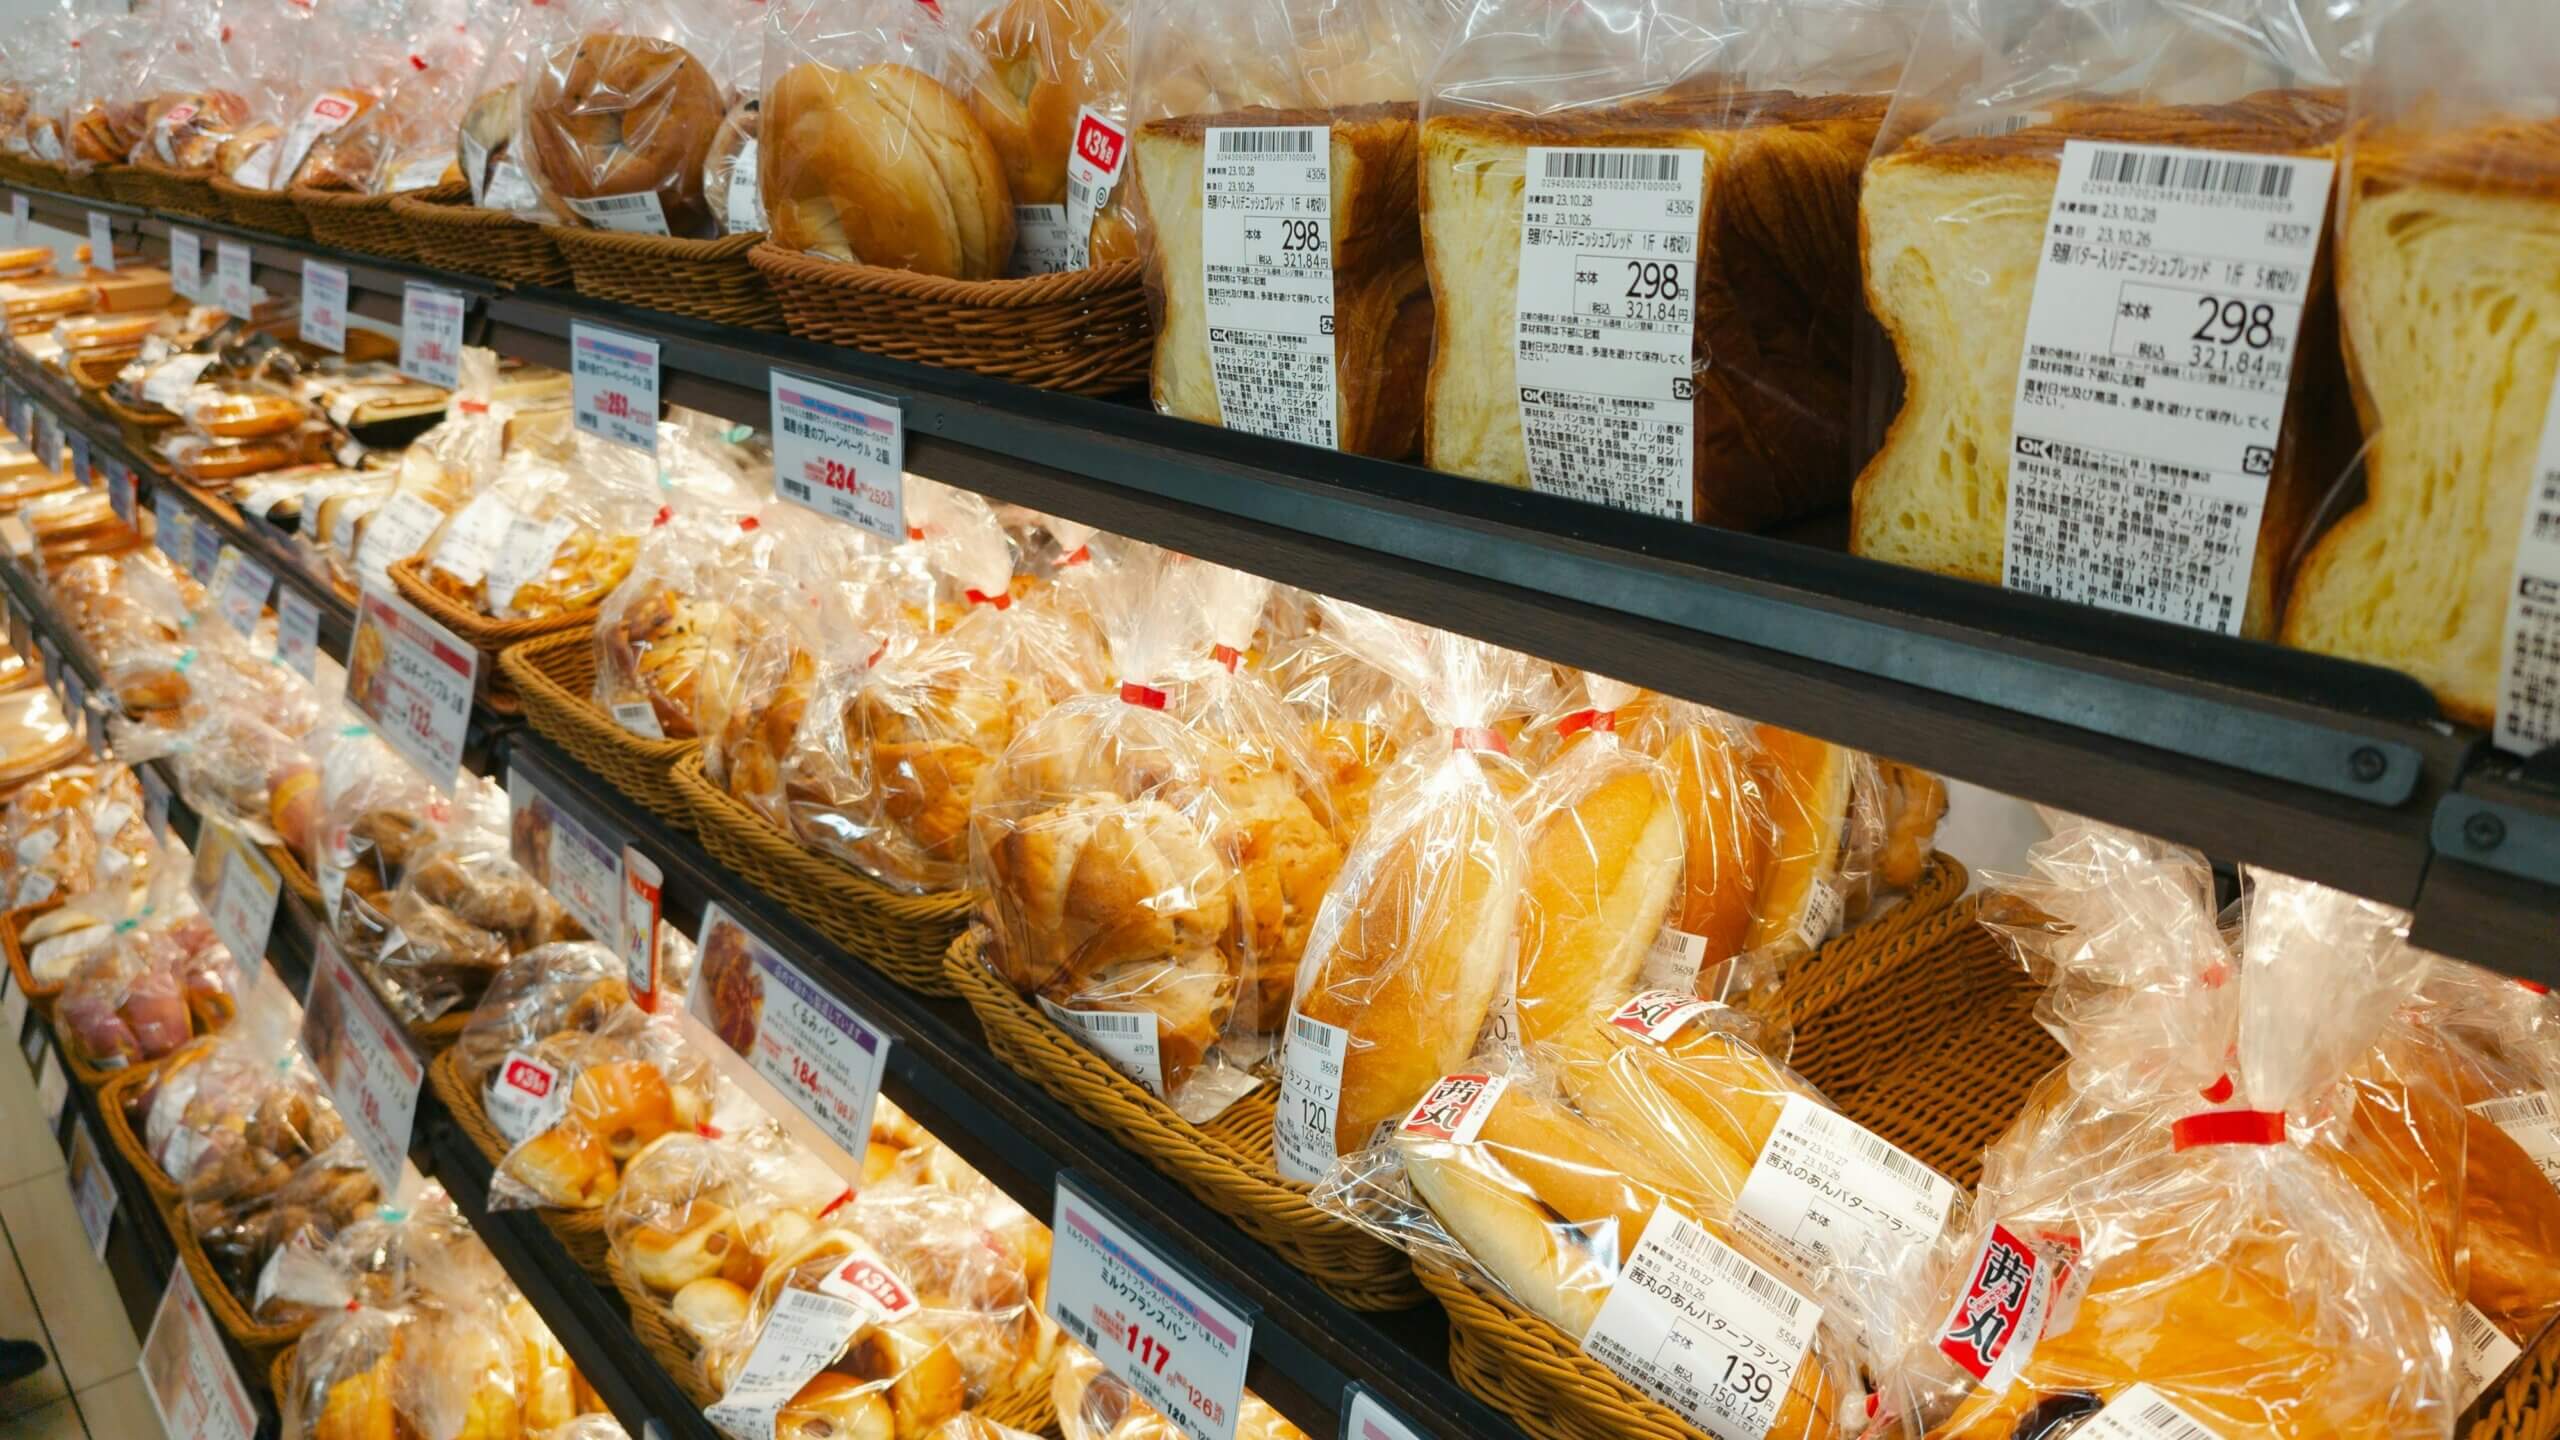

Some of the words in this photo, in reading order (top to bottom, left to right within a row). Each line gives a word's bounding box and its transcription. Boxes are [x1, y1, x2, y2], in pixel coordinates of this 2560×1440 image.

[1228, 167, 1255, 176] 23.10.28
[1306, 169, 1326, 180] 4306
[1292, 198, 1300, 211] 1斤
[1306, 199, 1326, 212] 4枚切り
[1556, 195, 1593, 206] 23.10.28
[1667, 200, 1694, 215] 4306
[1555, 213, 1591, 226] 23.10.26
[2102, 204, 2156, 223] 23.10.28
[2267, 222, 2311, 244] 4307
[1246, 230, 1261, 240] 本体
[1643, 235, 1655, 252] 1斤
[1663, 236, 1691, 253] 4枚切り
[2097, 228, 2151, 246] 23.10.26
[1259, 256, 1272, 264] 税込
[1284, 252, 1329, 268] 321.84円
[1576, 271, 1598, 284] 本体
[2226, 264, 2244, 282] 1斤
[2256, 269, 2299, 293] 5枚切り
[1592, 302, 1611, 314] 税込
[1626, 302, 1689, 321] 321.84円
[2119, 301, 2153, 320] 本体
[1212, 330, 1226, 339] OK
[2138, 342, 2166, 361] 税込
[2188, 345, 2281, 379] 321.84円
[1523, 390, 1542, 402] OK
[2019, 438, 2046, 457] OK
[790, 997, 839, 1050] くるみパン
[1410, 1080, 1483, 1130] 茜丸
[1808, 1141, 1848, 1168] 23.10.27
[1801, 1154, 1842, 1180] 23.10.26
[1804, 1208, 1833, 1228] 本体
[1634, 1253, 1662, 1274] 製造日
[1666, 1271, 1707, 1301] 23.10.26
[1099, 1264, 1188, 1346] ミルクフランスパン
[1672, 1258, 1714, 1288] 23.10.27
[1776, 1326, 1804, 1350] 5584
[1949, 1242, 2033, 1363] 茜丸
[1624, 1265, 1796, 1378] 茜丸のあんバターフランス
[1666, 1328, 1695, 1352] 本体
[1671, 1363, 1695, 1382] 税込
[1706, 1382, 1771, 1428] 150.12円
